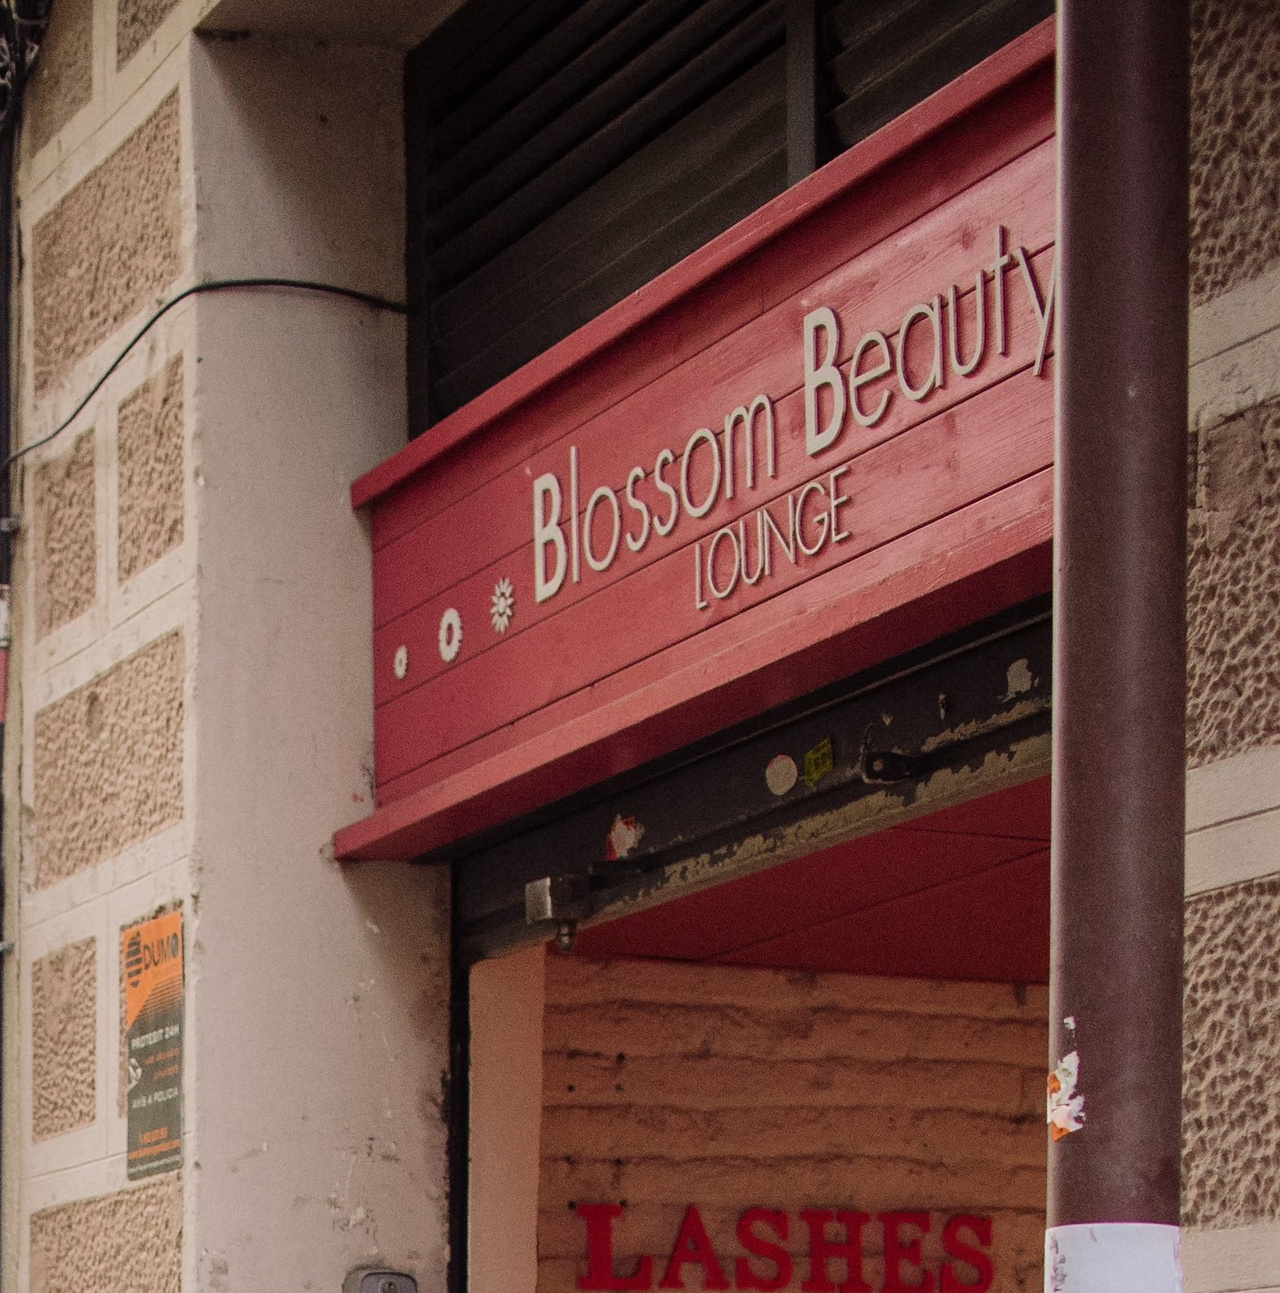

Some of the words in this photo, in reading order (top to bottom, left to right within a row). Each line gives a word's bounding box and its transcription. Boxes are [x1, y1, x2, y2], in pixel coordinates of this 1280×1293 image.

[531, 392, 777, 604] Blossom
[802, 225, 1057, 459] Beauty
[694, 466, 852, 611] LOUNGE
